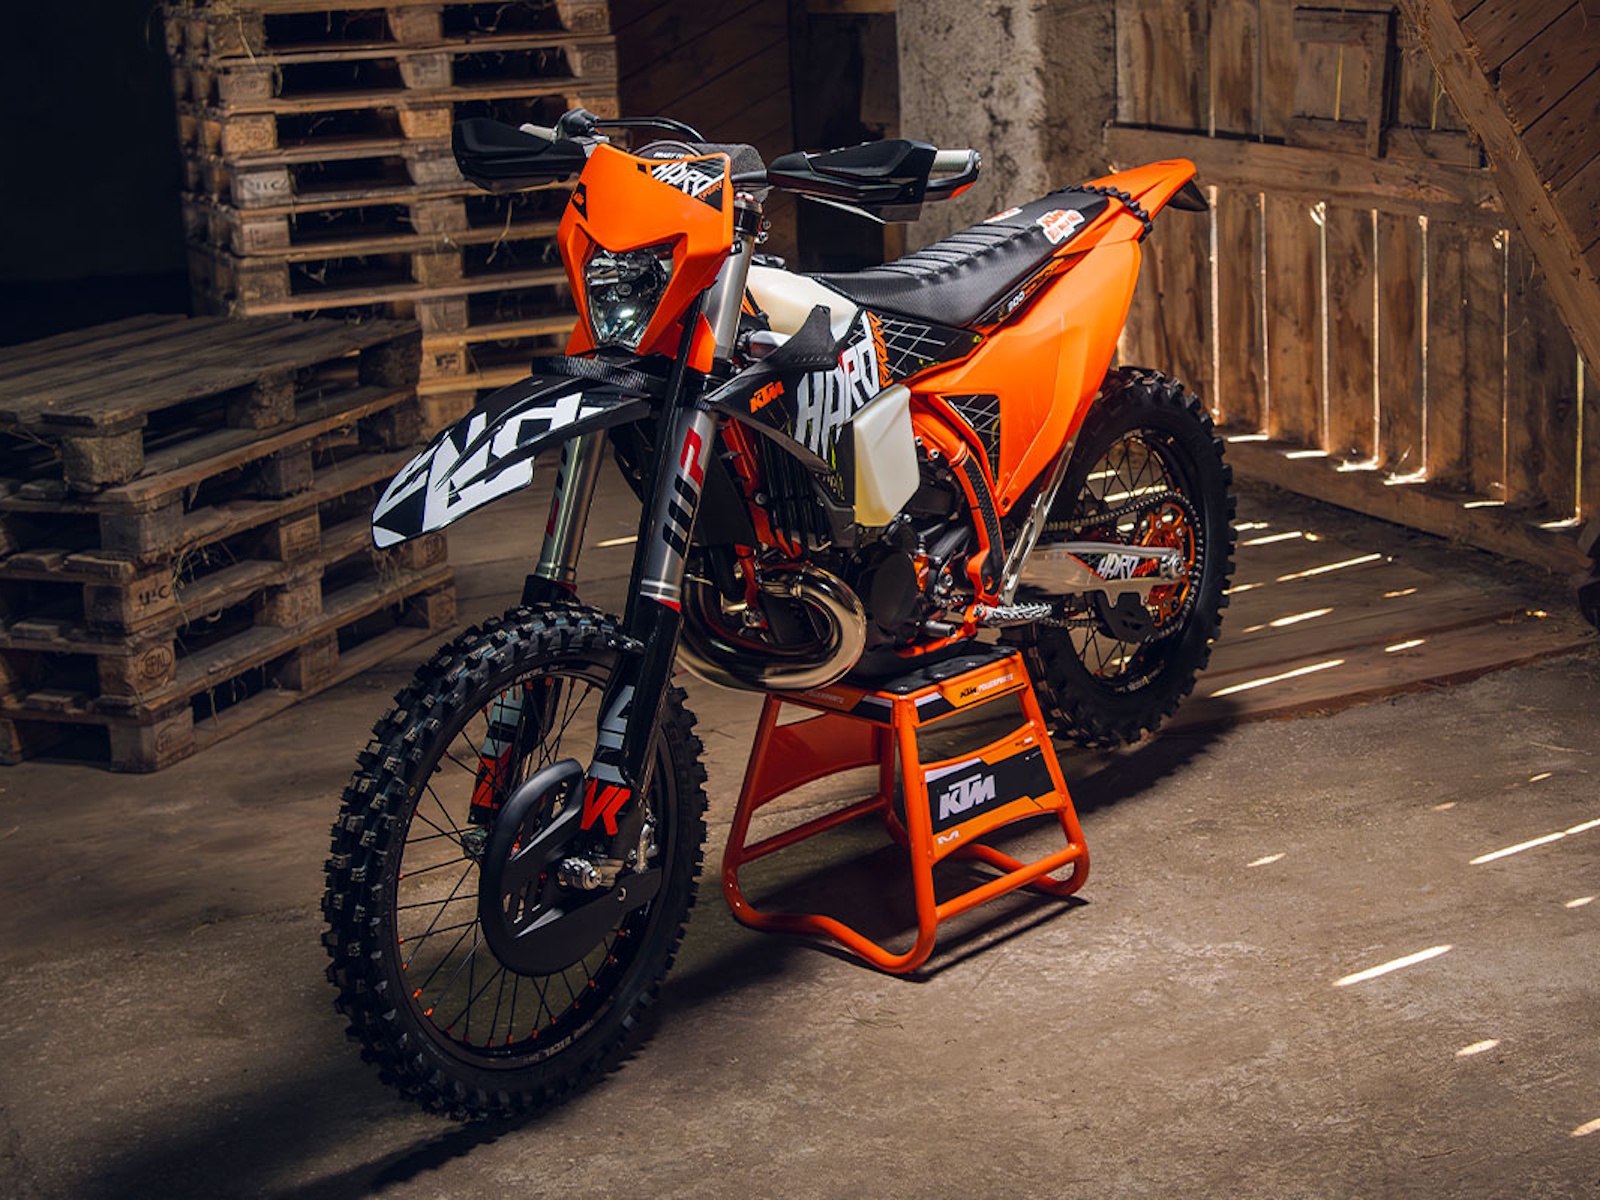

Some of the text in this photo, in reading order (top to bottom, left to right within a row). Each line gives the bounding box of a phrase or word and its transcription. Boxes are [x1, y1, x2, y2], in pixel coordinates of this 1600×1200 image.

[651, 161, 725, 198] HARD
[750, 380, 785, 414] KTM
[1096, 552, 1140, 581] HARD
[939, 773, 997, 821] KTM
